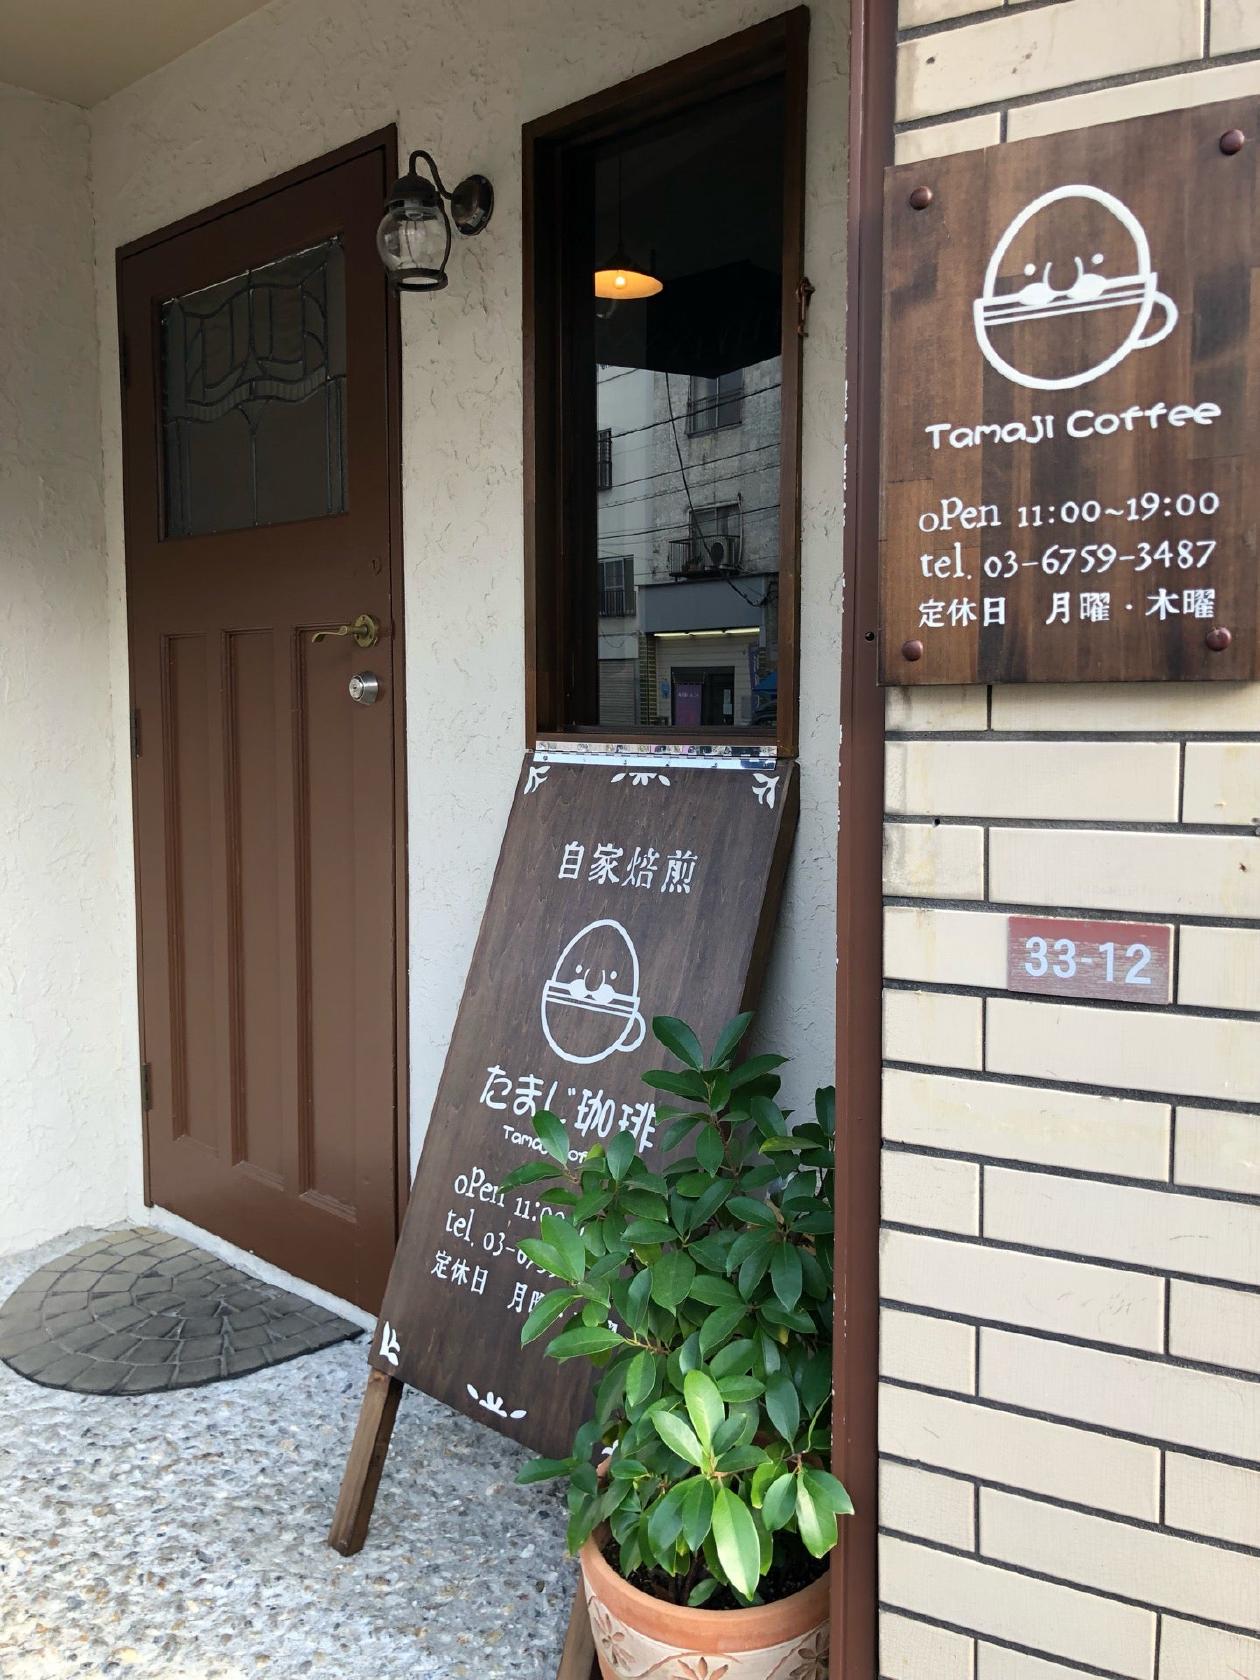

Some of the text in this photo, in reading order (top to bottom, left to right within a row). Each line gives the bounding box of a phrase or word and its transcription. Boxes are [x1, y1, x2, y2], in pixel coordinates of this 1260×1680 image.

[1067, 402, 1221, 437] Coffee
[919, 540, 1216, 580] tel. 03-6759-3487
[918, 597, 1005, 627] 定休日
[558, 841, 698, 893] 自家焙煎
[1025, 936, 1152, 984] 33-12
[502, 1124, 549, 1155] Tama
[446, 1208, 475, 1247] tel.
[430, 1250, 489, 1295] 定休日
